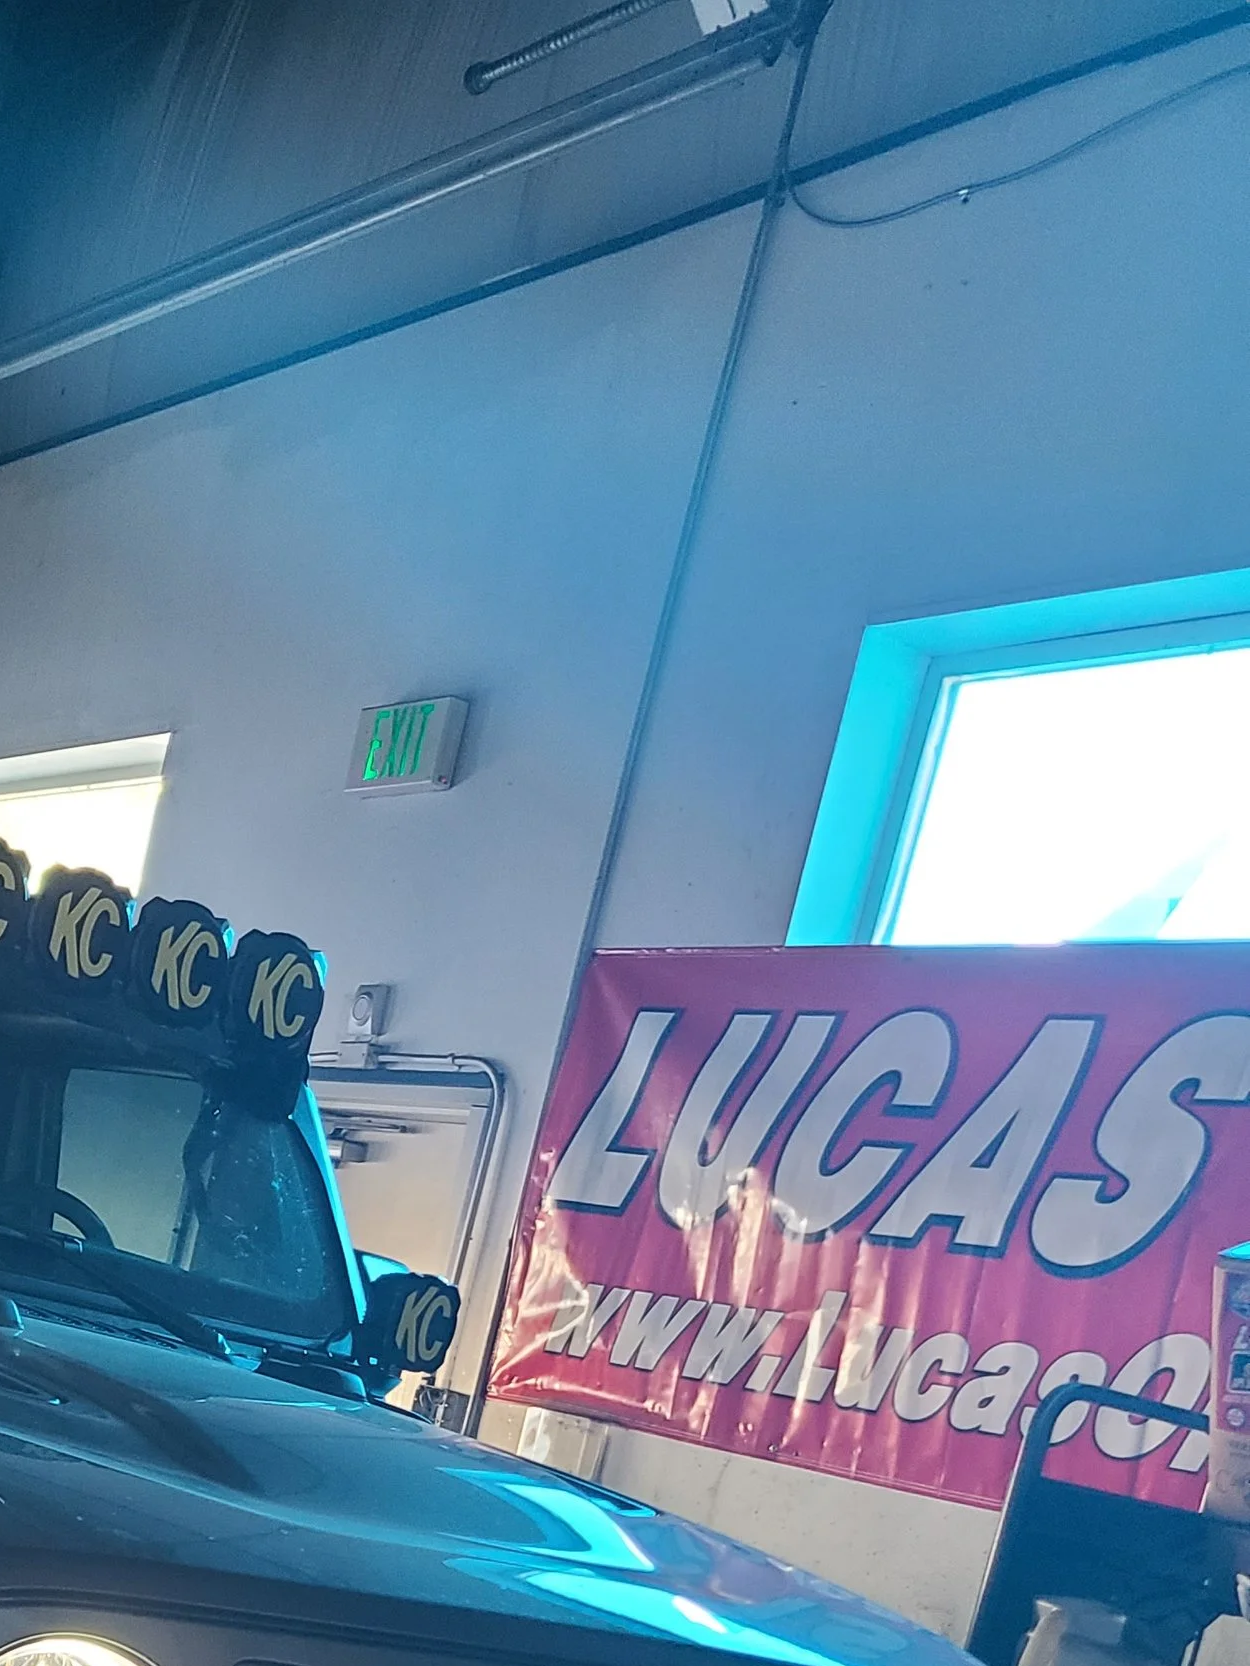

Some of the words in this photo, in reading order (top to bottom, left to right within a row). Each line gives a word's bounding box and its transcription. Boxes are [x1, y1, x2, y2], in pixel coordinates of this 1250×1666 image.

[363, 703, 435, 781] EXIT
[50, 886, 121, 977] KC
[151, 921, 220, 1010] KC
[249, 953, 313, 1039] KC
[545, 1007, 1250, 1279] LUCAS
[395, 1285, 452, 1362] KC
